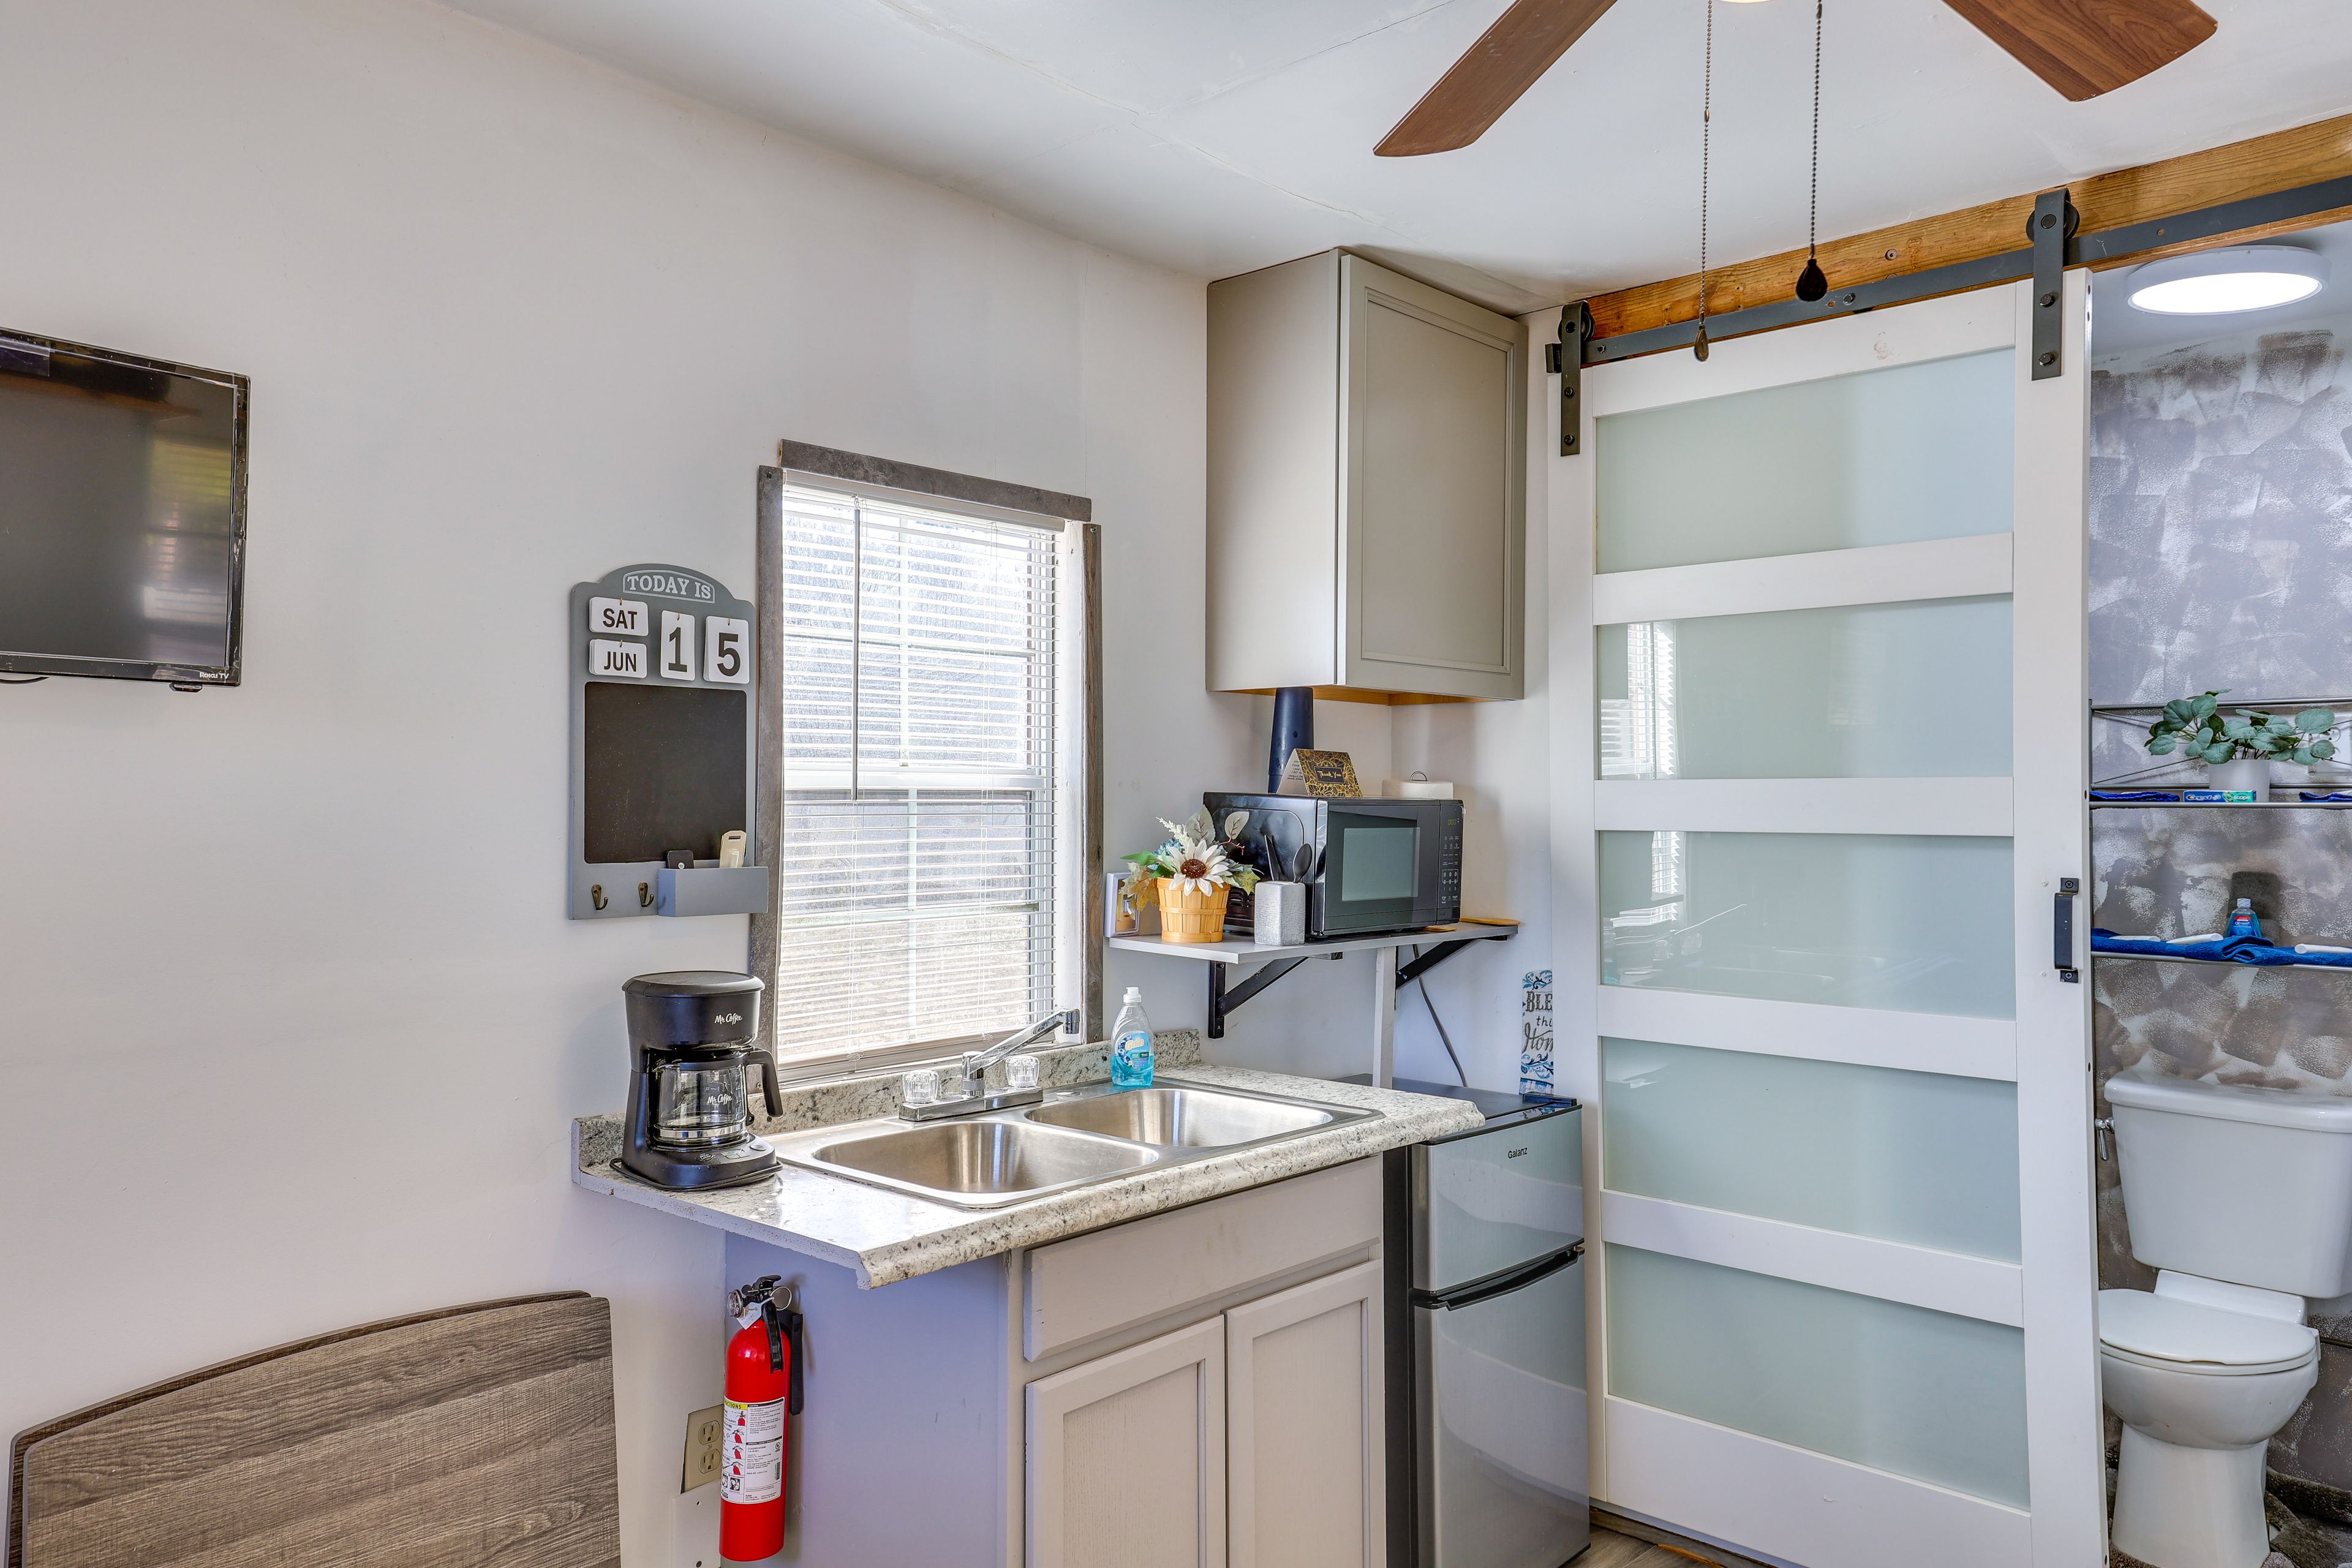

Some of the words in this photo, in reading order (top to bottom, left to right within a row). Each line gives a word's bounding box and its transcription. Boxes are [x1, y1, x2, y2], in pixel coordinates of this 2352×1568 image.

[627, 575, 690, 595] TODAY
[695, 581, 711, 599] IS
[603, 608, 638, 630] SAT
[668, 626, 688, 673] 1
[717, 632, 741, 677] 5
[603, 650, 637, 673] JUN
[715, 1014, 725, 1025] Mr.
[726, 1012, 743, 1025] Coffee
[1536, 1016, 1553, 1027] thi
[707, 1095, 717, 1106] Mr.
[717, 1093, 733, 1105] Coffee
[1507, 1147, 1528, 1159] Galanz
